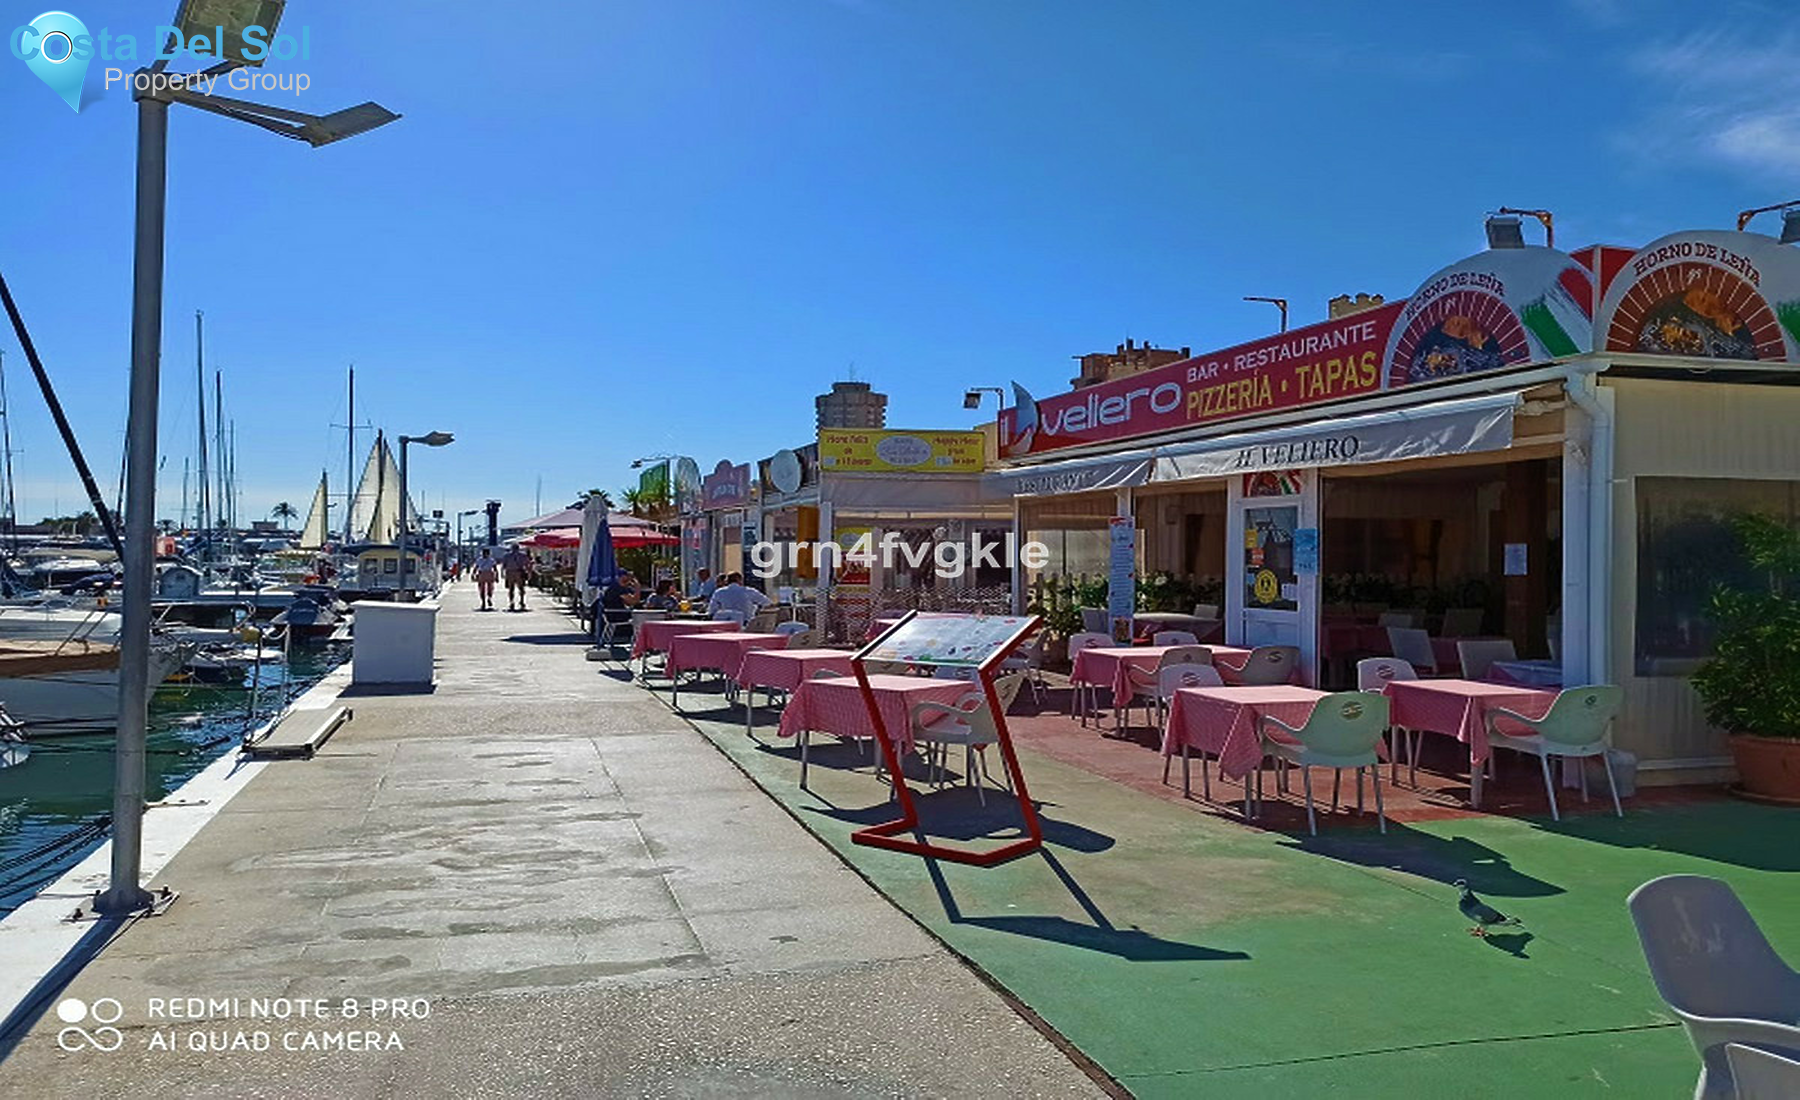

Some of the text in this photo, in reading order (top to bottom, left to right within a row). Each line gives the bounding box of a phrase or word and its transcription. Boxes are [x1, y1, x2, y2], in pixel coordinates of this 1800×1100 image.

[1633, 242, 1692, 277] HORNO
[1695, 242, 1718, 260] DE
[1187, 320, 1376, 383] BAR RESTAURANTE
[1187, 351, 1376, 420] PIZZERÍA TAPAS
[1260, 435, 1359, 465] VELIERO
